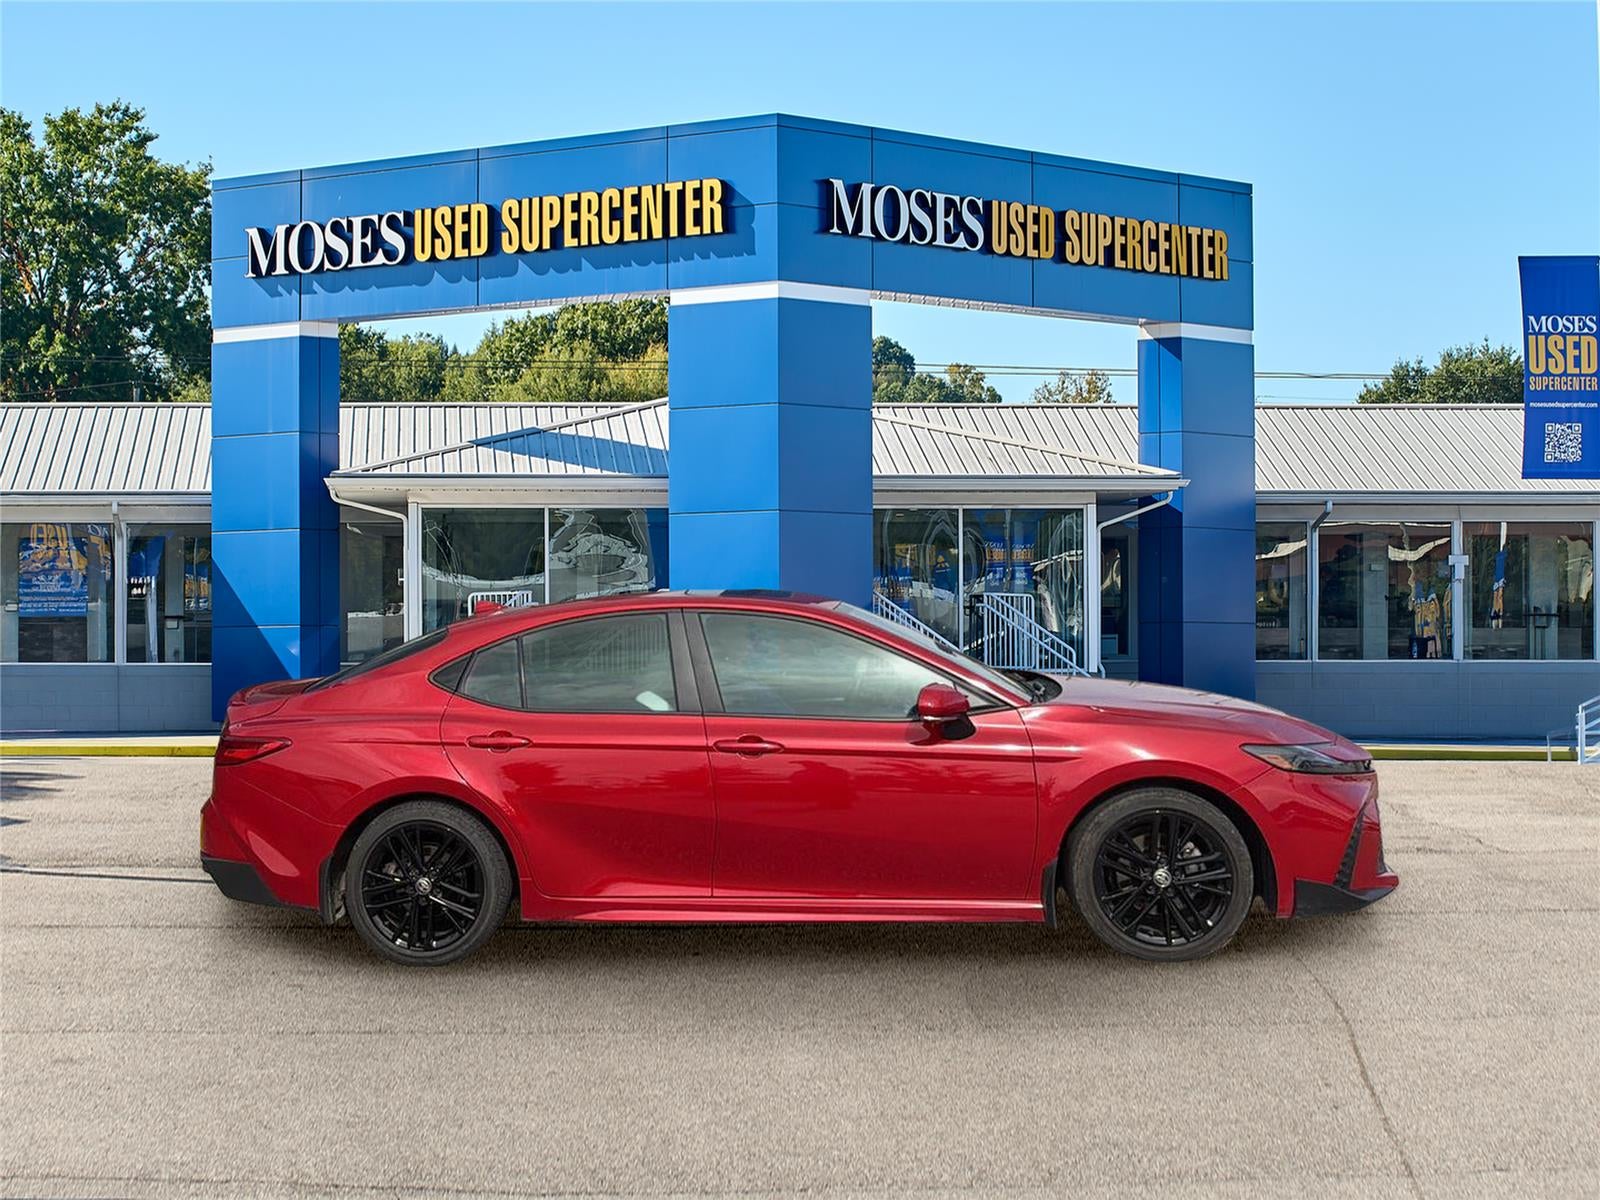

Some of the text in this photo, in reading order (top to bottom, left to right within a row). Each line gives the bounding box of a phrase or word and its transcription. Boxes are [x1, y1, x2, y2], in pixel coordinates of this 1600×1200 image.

[245, 178, 723, 278] MOSES USED SUPERCENTER
[829, 178, 1229, 281] MOSES USED SUPERCENTER
[1528, 316, 1597, 333] MOSES
[1528, 335, 1598, 374] USED
[1529, 376, 1598, 391] SUPERCENTER
